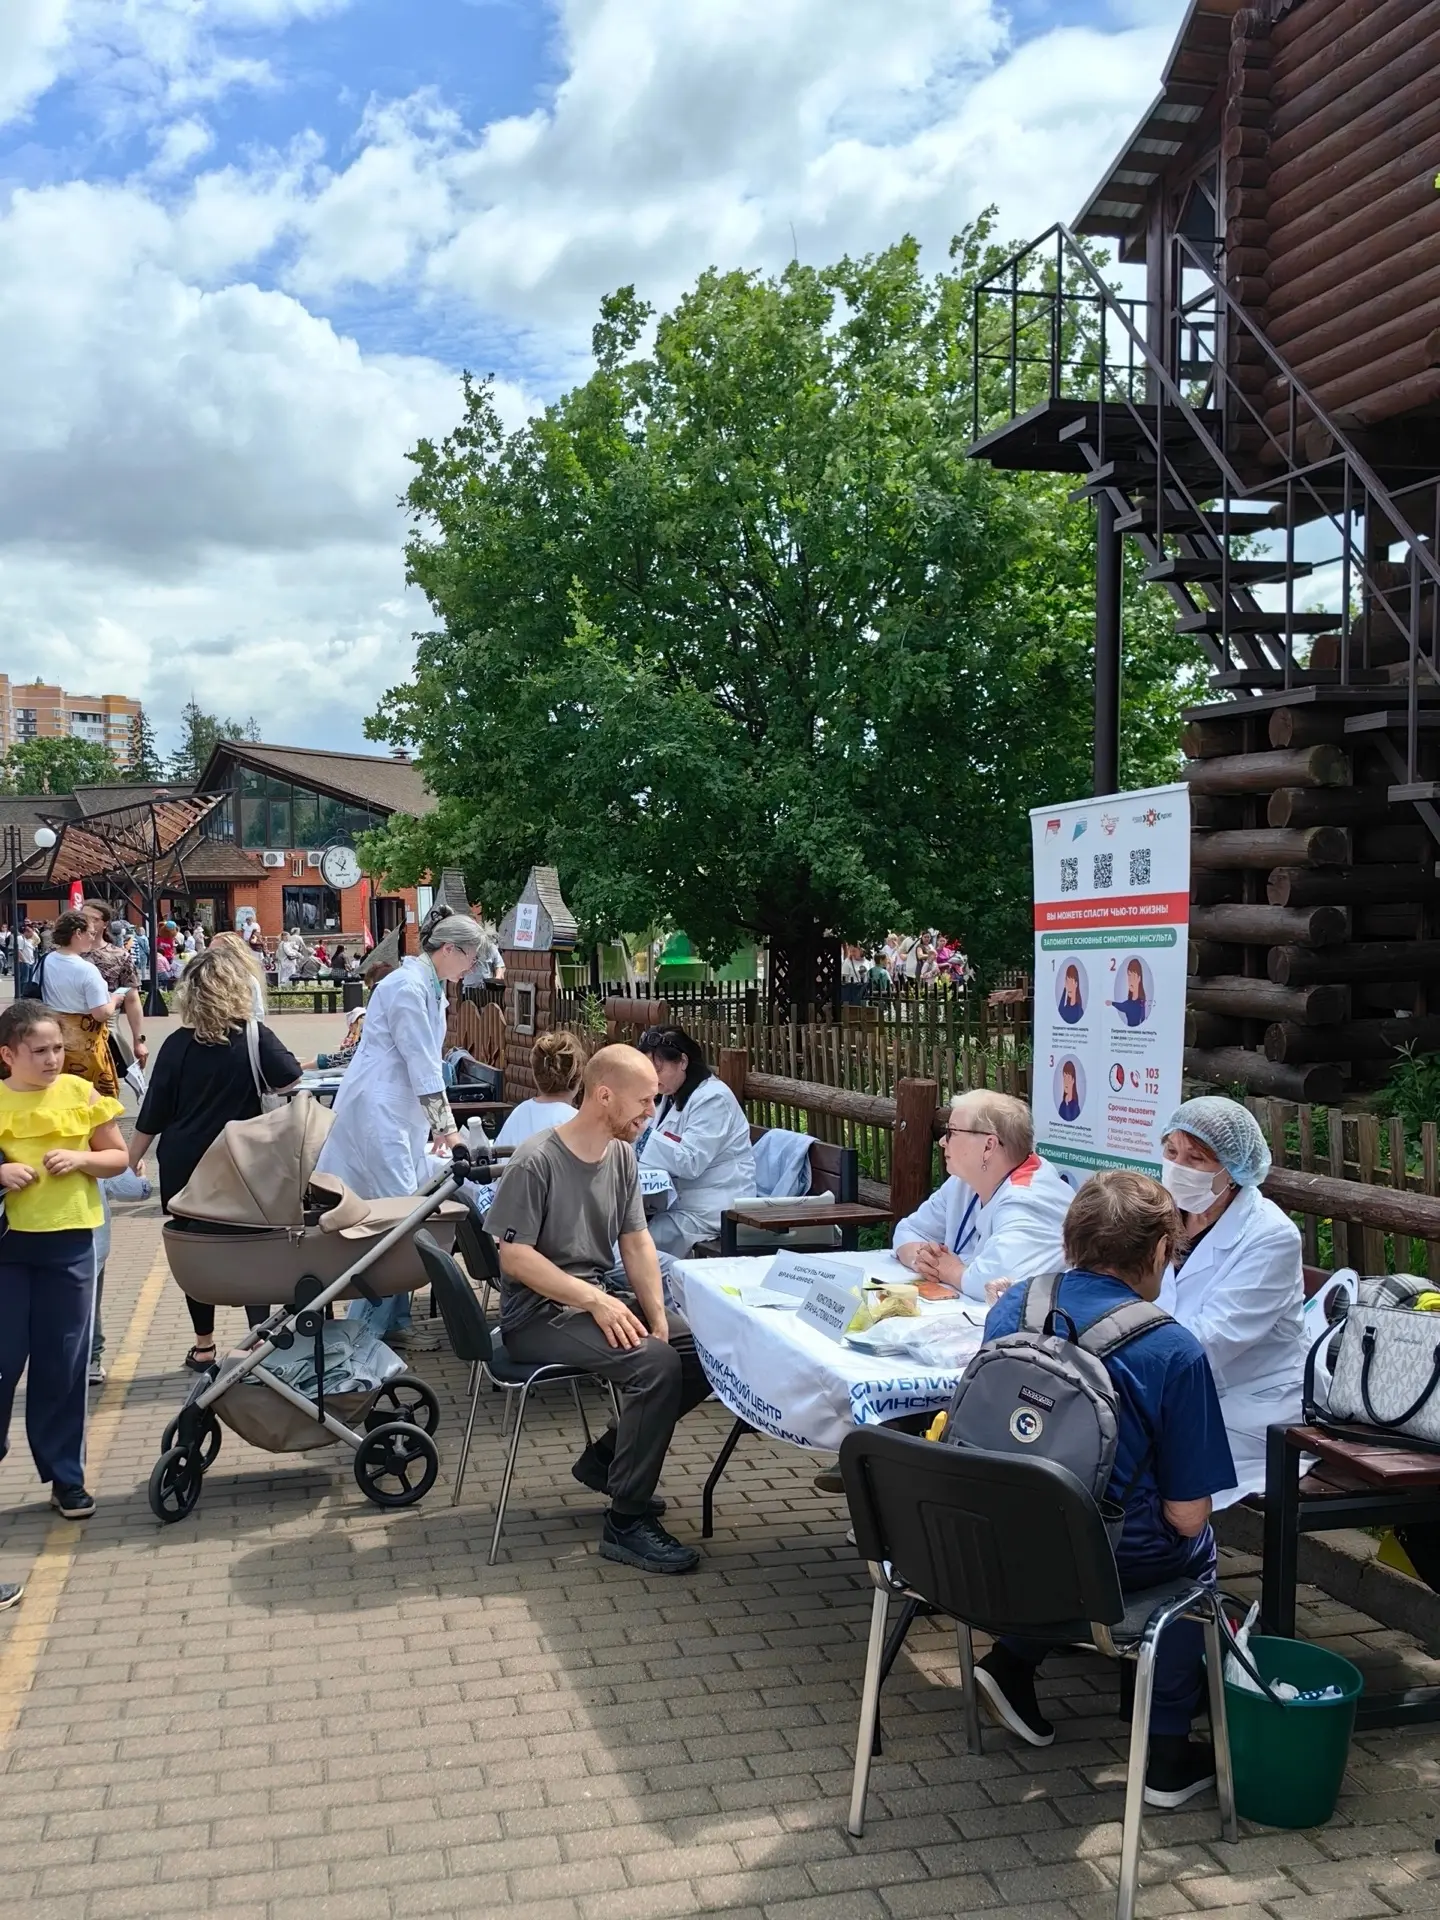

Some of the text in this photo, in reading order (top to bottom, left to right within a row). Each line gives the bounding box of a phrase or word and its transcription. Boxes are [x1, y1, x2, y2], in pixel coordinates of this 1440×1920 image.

[1046, 912, 1056, 921] ВЫ
[1057, 910, 1083, 920] МОЖЕТЕ
[1083, 908, 1109, 919] СПАСТИ
[1110, 906, 1138, 917] ЧЬЮ-ТО
[1043, 933, 1173, 946] ЗАПОМНИТЕ ОСНОВНЫЕ СИМПТОМЫ ИНСУЛЬТА
[1051, 959, 1056, 972] 1
[1109, 957, 1117, 972] 2
[1049, 1055, 1055, 1068] 3
[1145, 1067, 1160, 1080] 103
[1144, 1082, 1159, 1095] 112
[1107, 1102, 1156, 1117] Срочно вызовите
[1107, 1114, 1128, 1126] скорую
[1038, 1147, 1069, 1161] ЗАПОМНИТЕ
[1068, 1151, 1096, 1166] ПРИЗНАКИ
[1096, 1157, 1127, 1171] ИНФАРКТА
[793, 1265, 836, 1281] КОНСУЛЬТАЦИЯ
[815, 1292, 846, 1315] КОНСУЛЬТАЦИЯ
[751, 1392, 782, 1421] ЦЕНТР
